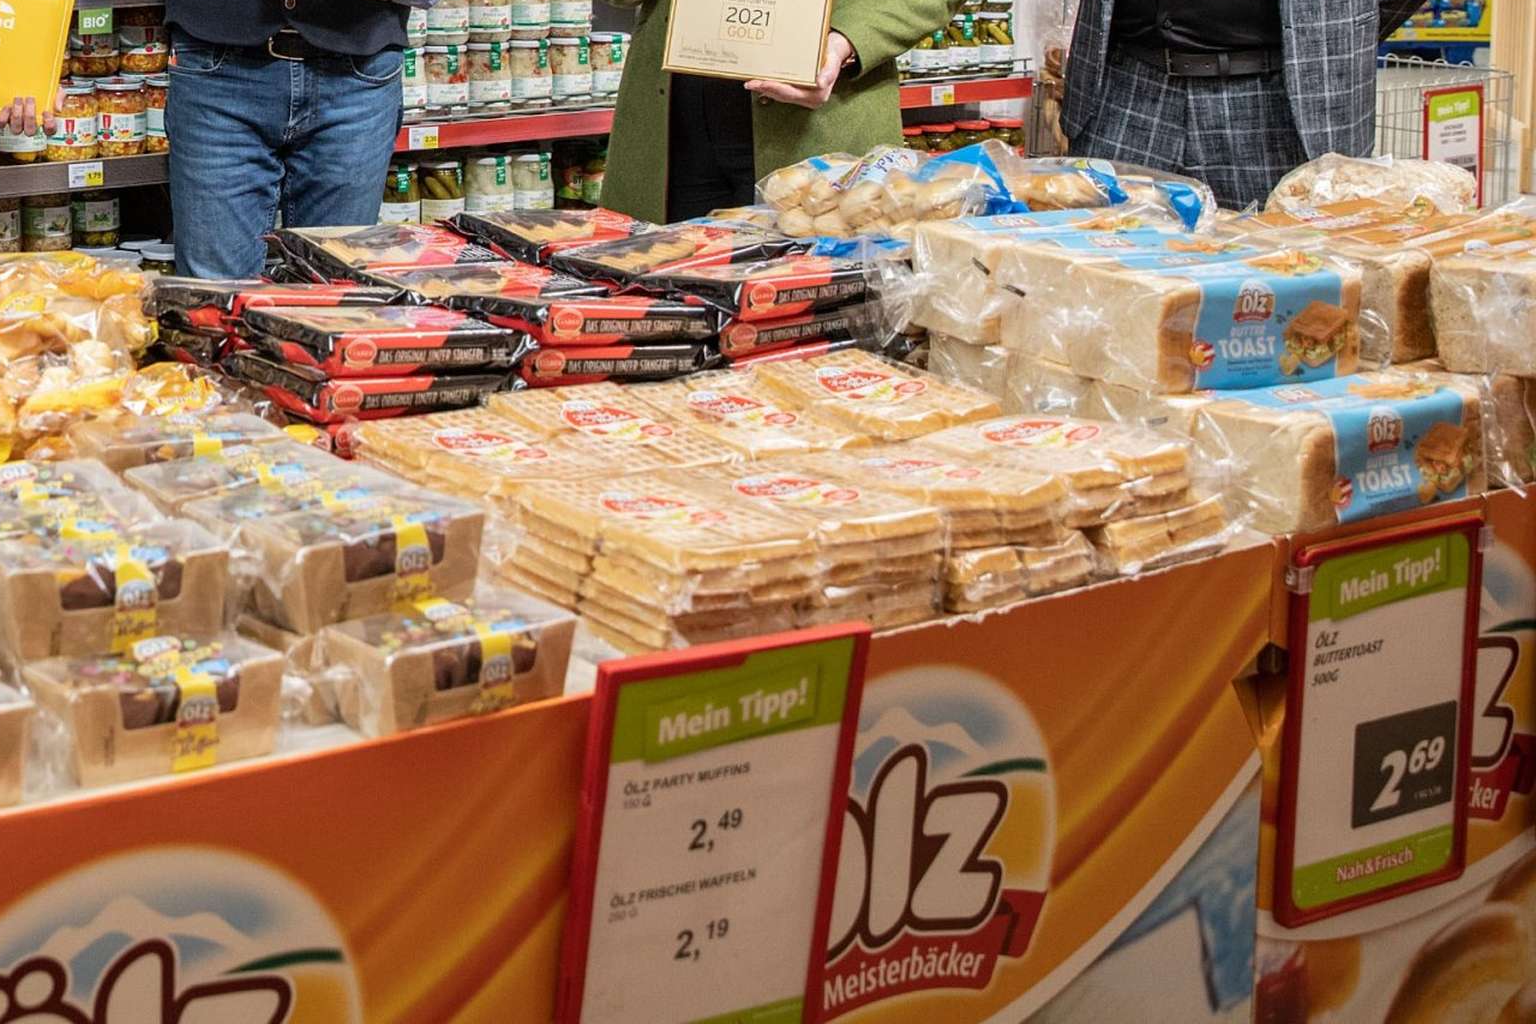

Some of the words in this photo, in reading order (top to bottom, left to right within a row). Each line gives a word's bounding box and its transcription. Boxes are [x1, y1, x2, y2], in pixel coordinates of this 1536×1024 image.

[83, 17, 105, 28] BIO
[726, 7, 770, 26] 2021
[727, 27, 764, 40] GOLD
[586, 319, 598, 332] DAS
[599, 320, 627, 332] ORIGINAL
[379, 350, 392, 363] DAS
[394, 349, 426, 362] ORIGINAL
[1219, 337, 1275, 358] TOAST
[568, 361, 581, 373] DAS
[583, 360, 613, 372] ORIGINAL
[1357, 465, 1412, 492] TOAST
[1340, 572, 1388, 604] Mein
[1394, 548, 1441, 586] Tipp!
[1314, 631, 1339, 650] ÖLZ
[1313, 639, 1385, 667] BUTTERTOAST
[658, 706, 731, 744] Mein
[739, 679, 809, 723] Tipp!
[624, 780, 649, 796] ÖLZ
[652, 773, 694, 790] PARTY
[697, 762, 751, 783] MUFFINS
[1336, 846, 1414, 881] Nah&Frisch
[610, 893, 636, 910] ÖLZ
[638, 882, 696, 904] FRISCHEI
[698, 868, 757, 890] WAFFELN
[823, 942, 985, 1010] Meisterbäcker
